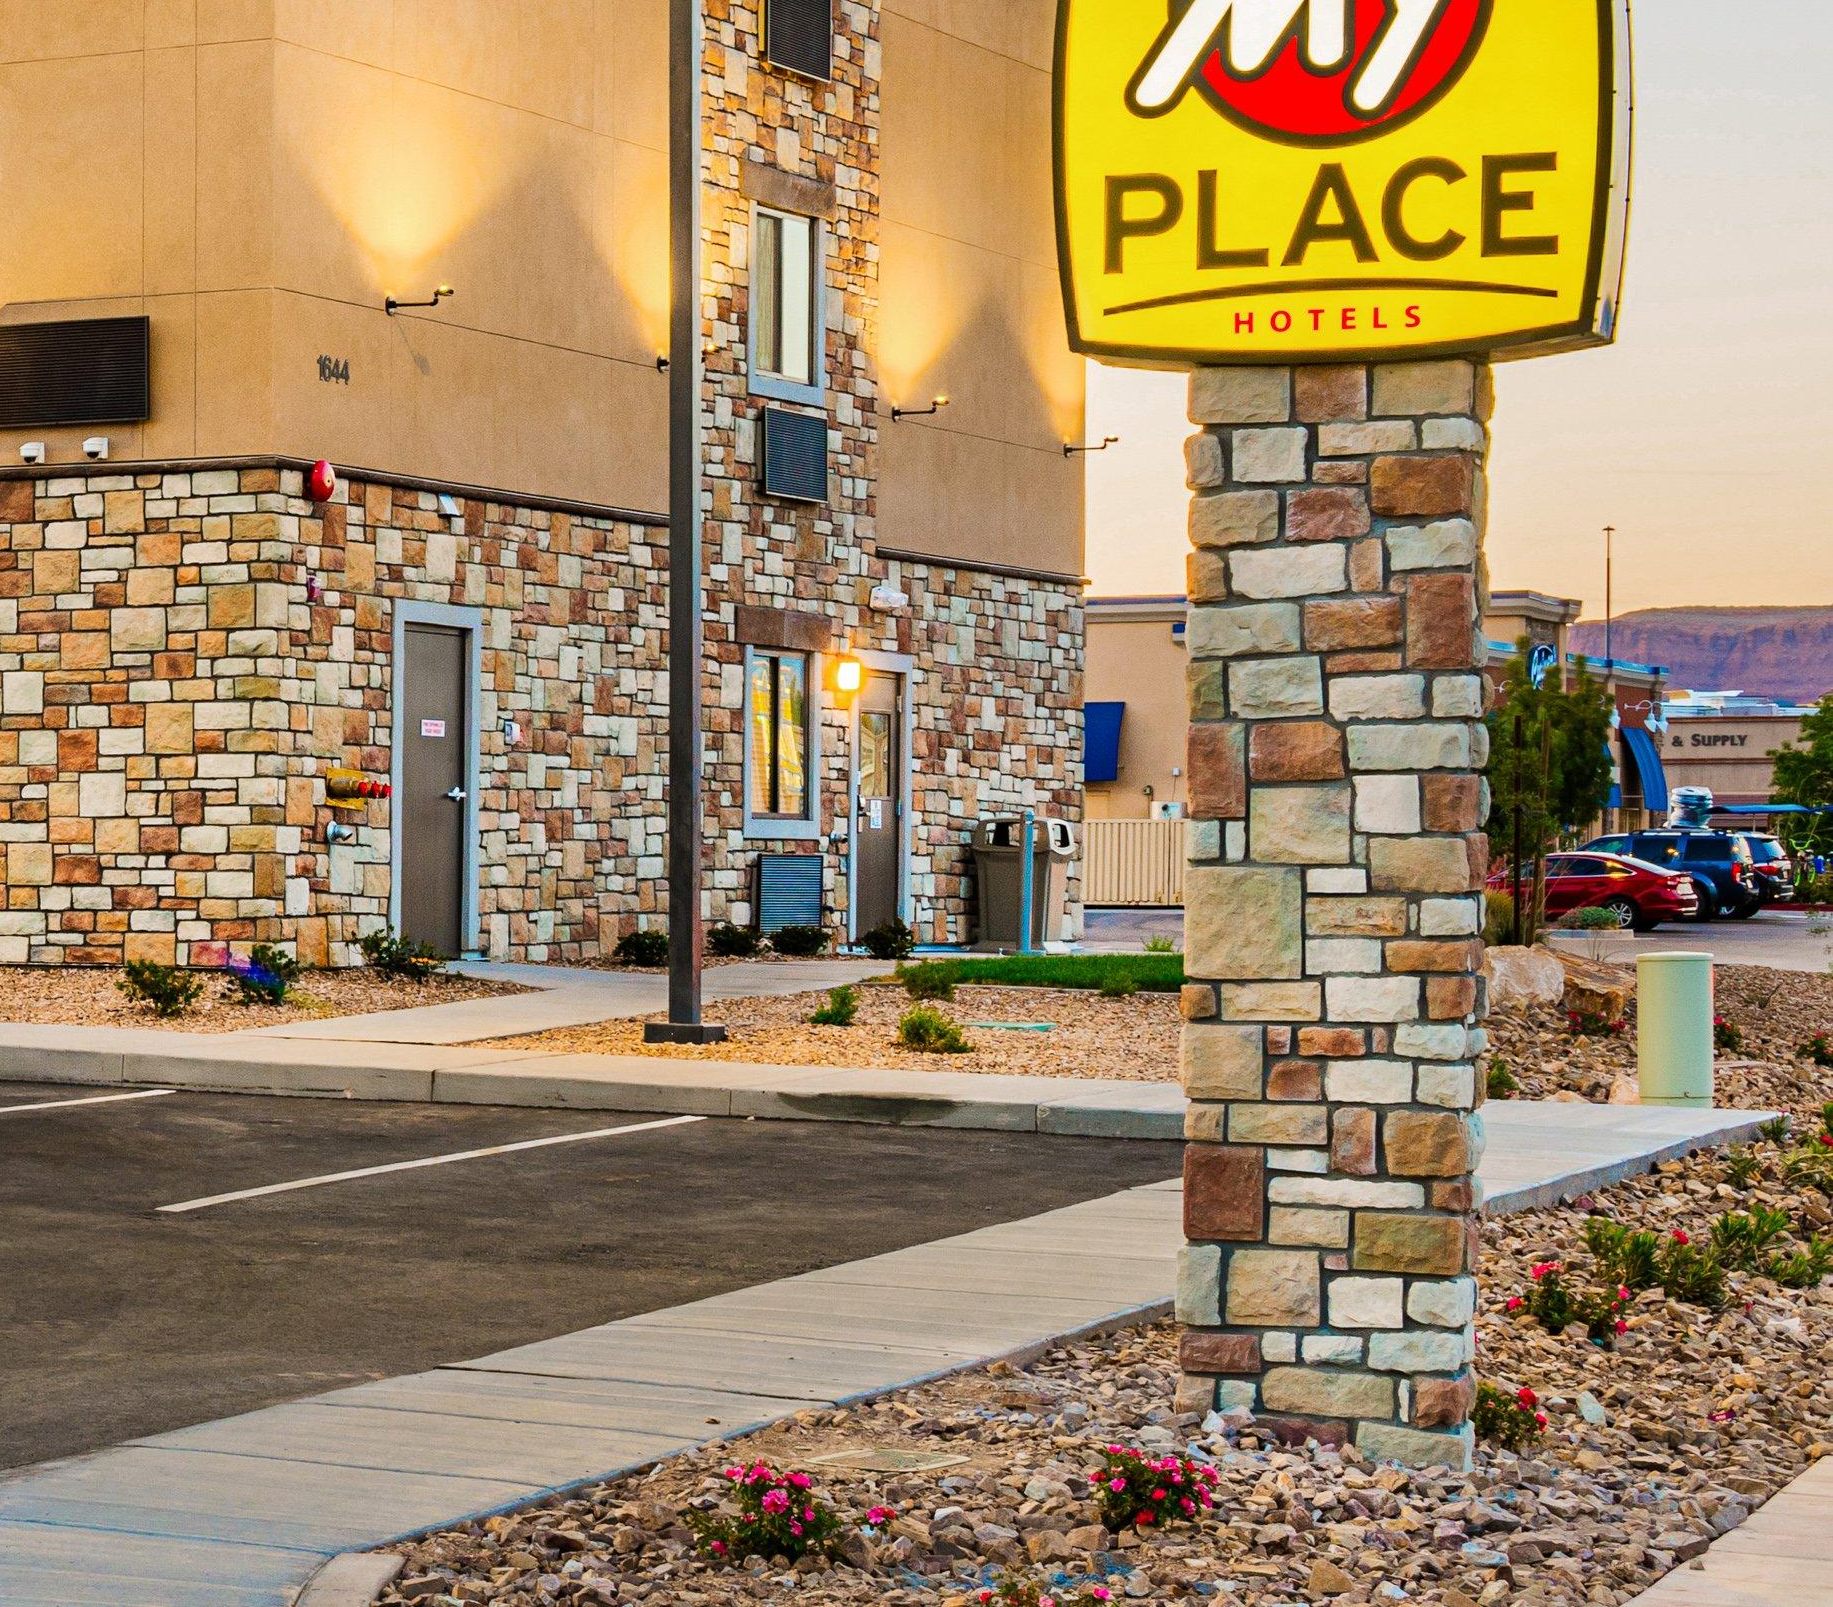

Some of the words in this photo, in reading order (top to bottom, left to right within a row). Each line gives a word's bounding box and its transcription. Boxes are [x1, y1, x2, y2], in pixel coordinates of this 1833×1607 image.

[1102, 150, 1559, 275] PLACE
[1233, 305, 1422, 334] HOTELS
[317, 354, 350, 385] 1644
[1671, 735, 1684, 747] &
